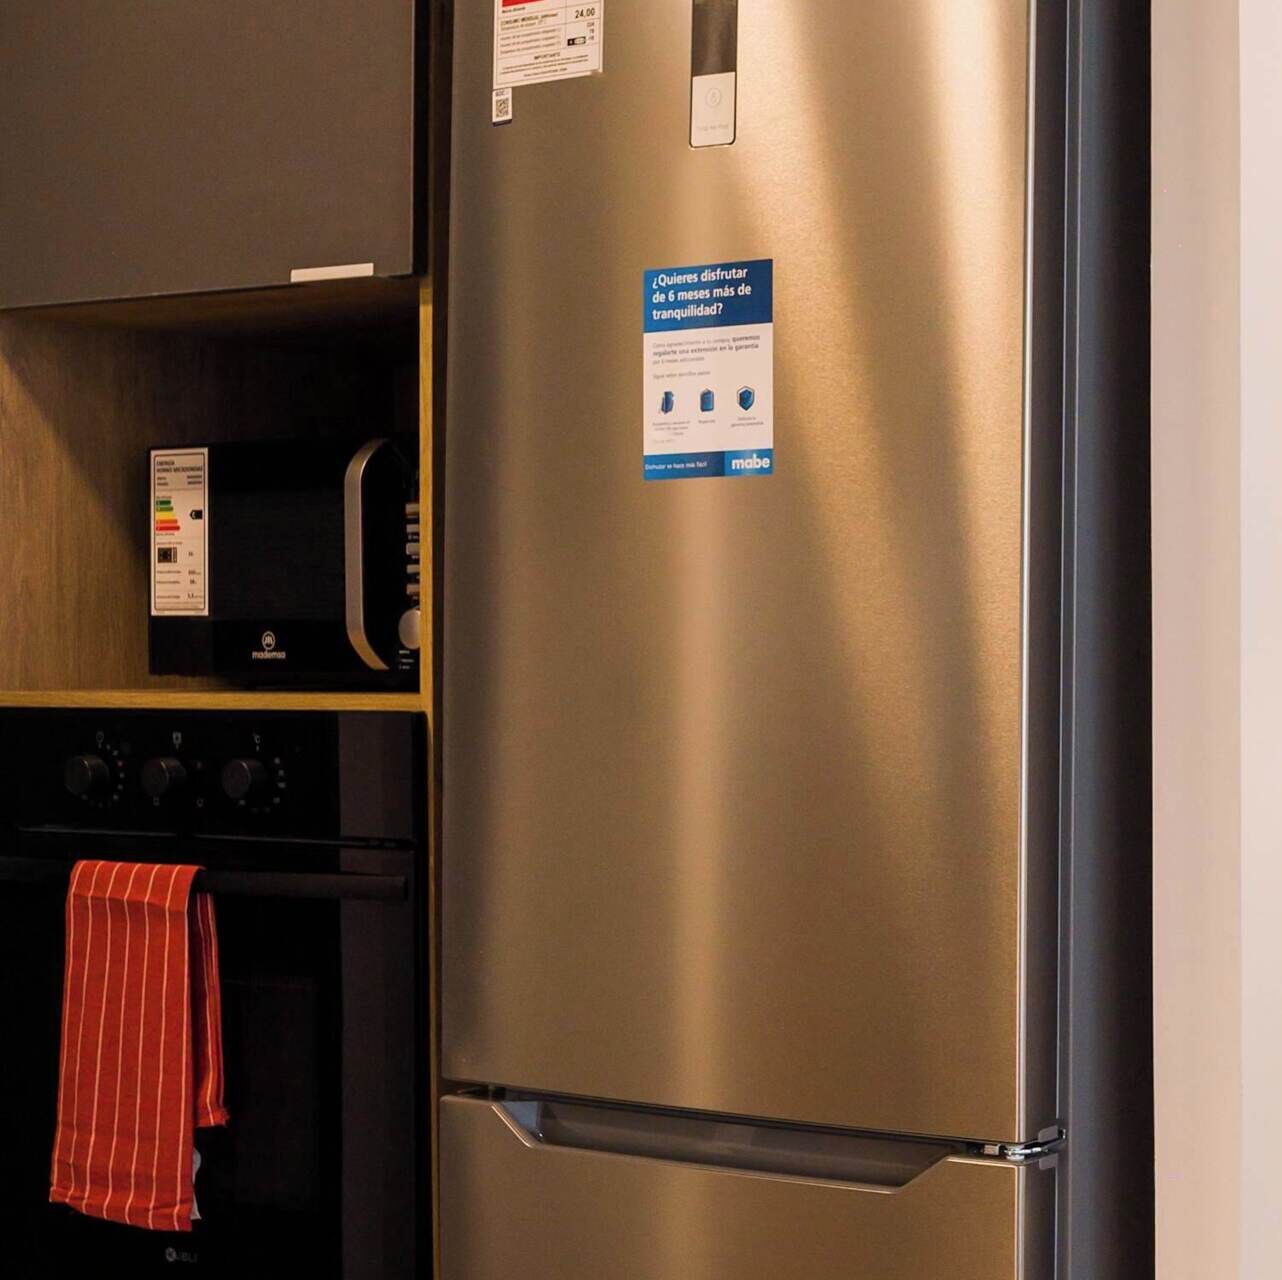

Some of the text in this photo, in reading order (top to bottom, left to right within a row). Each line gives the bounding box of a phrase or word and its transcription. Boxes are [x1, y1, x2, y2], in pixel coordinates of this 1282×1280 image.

[652, 268, 748, 289] ¿Quieres disfrutar
[652, 283, 752, 303] de 6 meses más de
[652, 302, 723, 320] tranquilidad?
[731, 453, 770, 470] mabe
